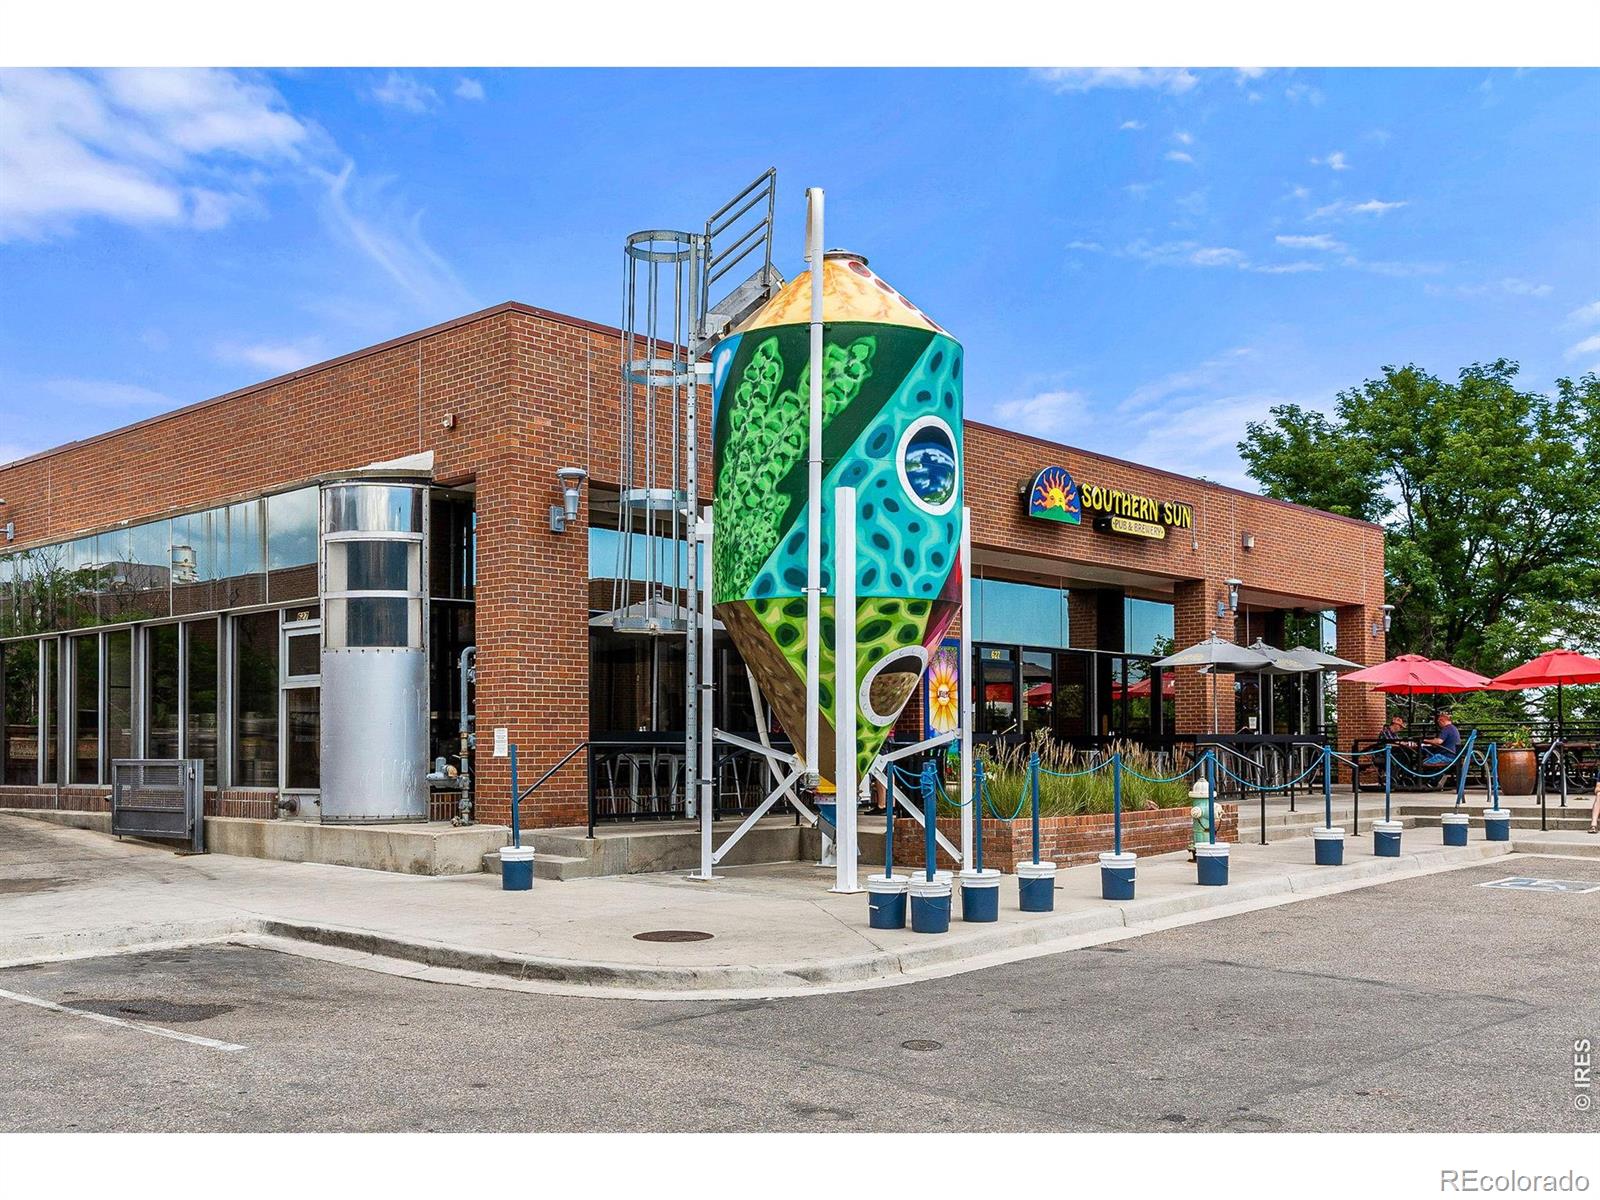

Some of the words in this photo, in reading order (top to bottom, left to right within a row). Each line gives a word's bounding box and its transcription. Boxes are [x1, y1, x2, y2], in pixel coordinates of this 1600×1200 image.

[1081, 482, 1159, 522] SOUTHERN
[1163, 501, 1192, 528] SUN
[1114, 519, 1128, 530] PUB
[1128, 523, 1134, 531] &
[1134, 523, 1162, 536] BREWERY
